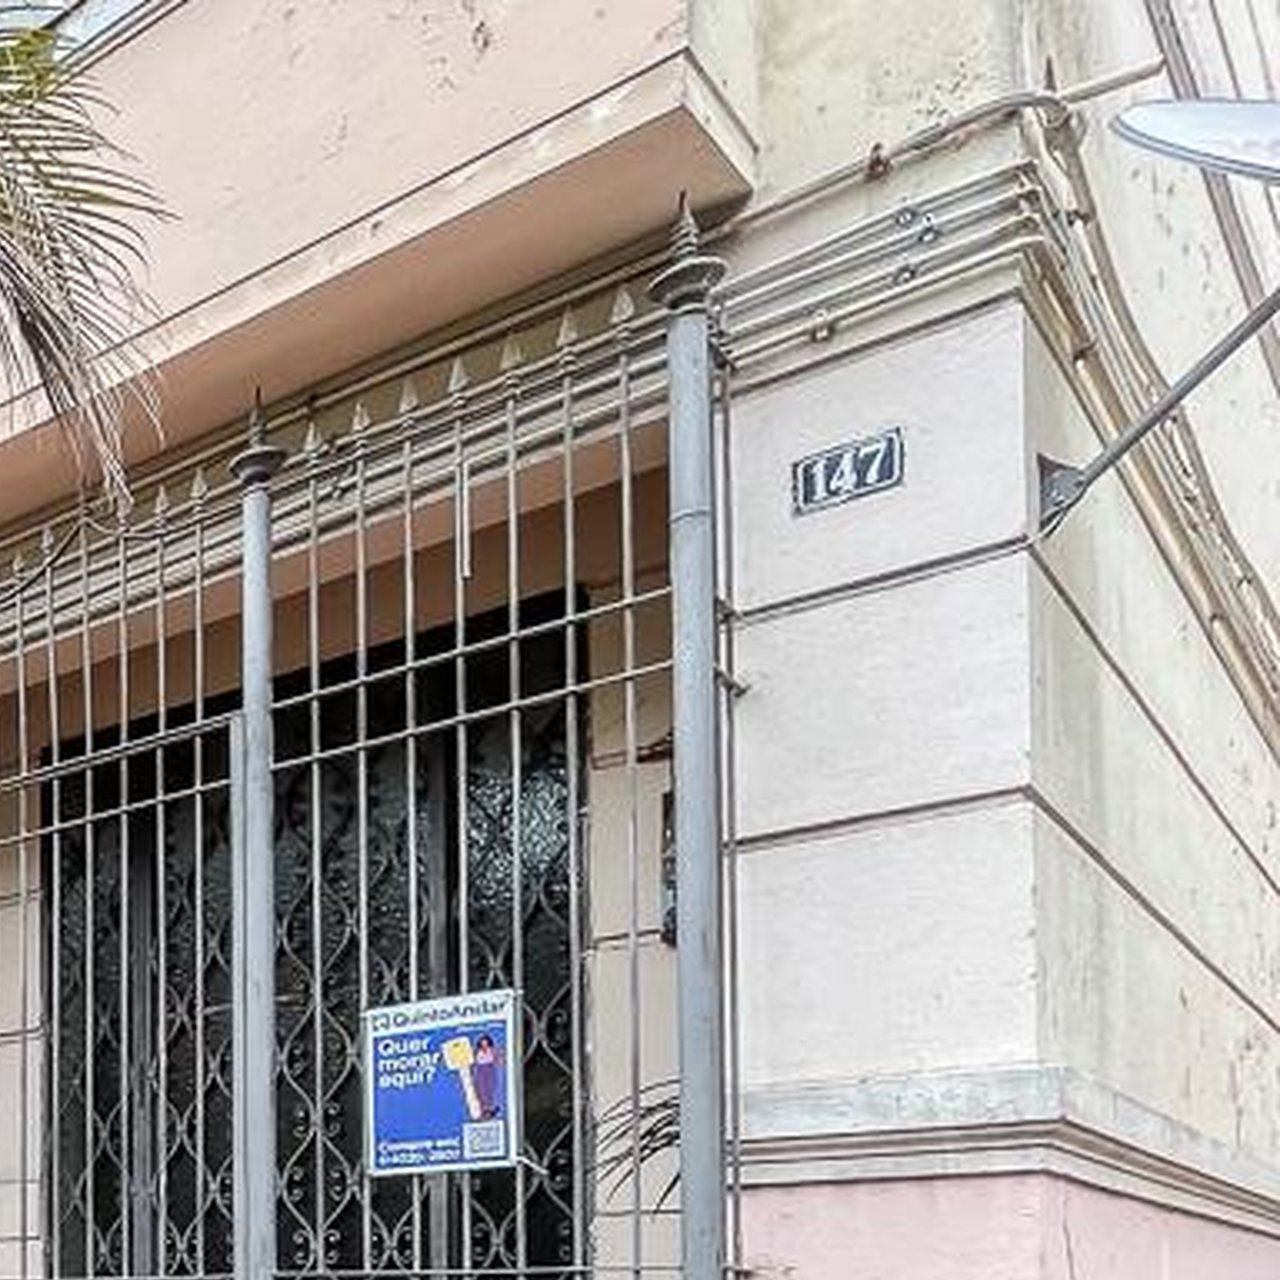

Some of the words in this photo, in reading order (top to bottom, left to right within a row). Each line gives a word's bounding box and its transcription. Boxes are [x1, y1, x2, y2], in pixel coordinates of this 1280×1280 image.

[811, 440, 885, 500] 147
[393, 1002, 506, 1028] QuintoAndar
[377, 1037, 429, 1056] Quer
[378, 1052, 440, 1073] morar
